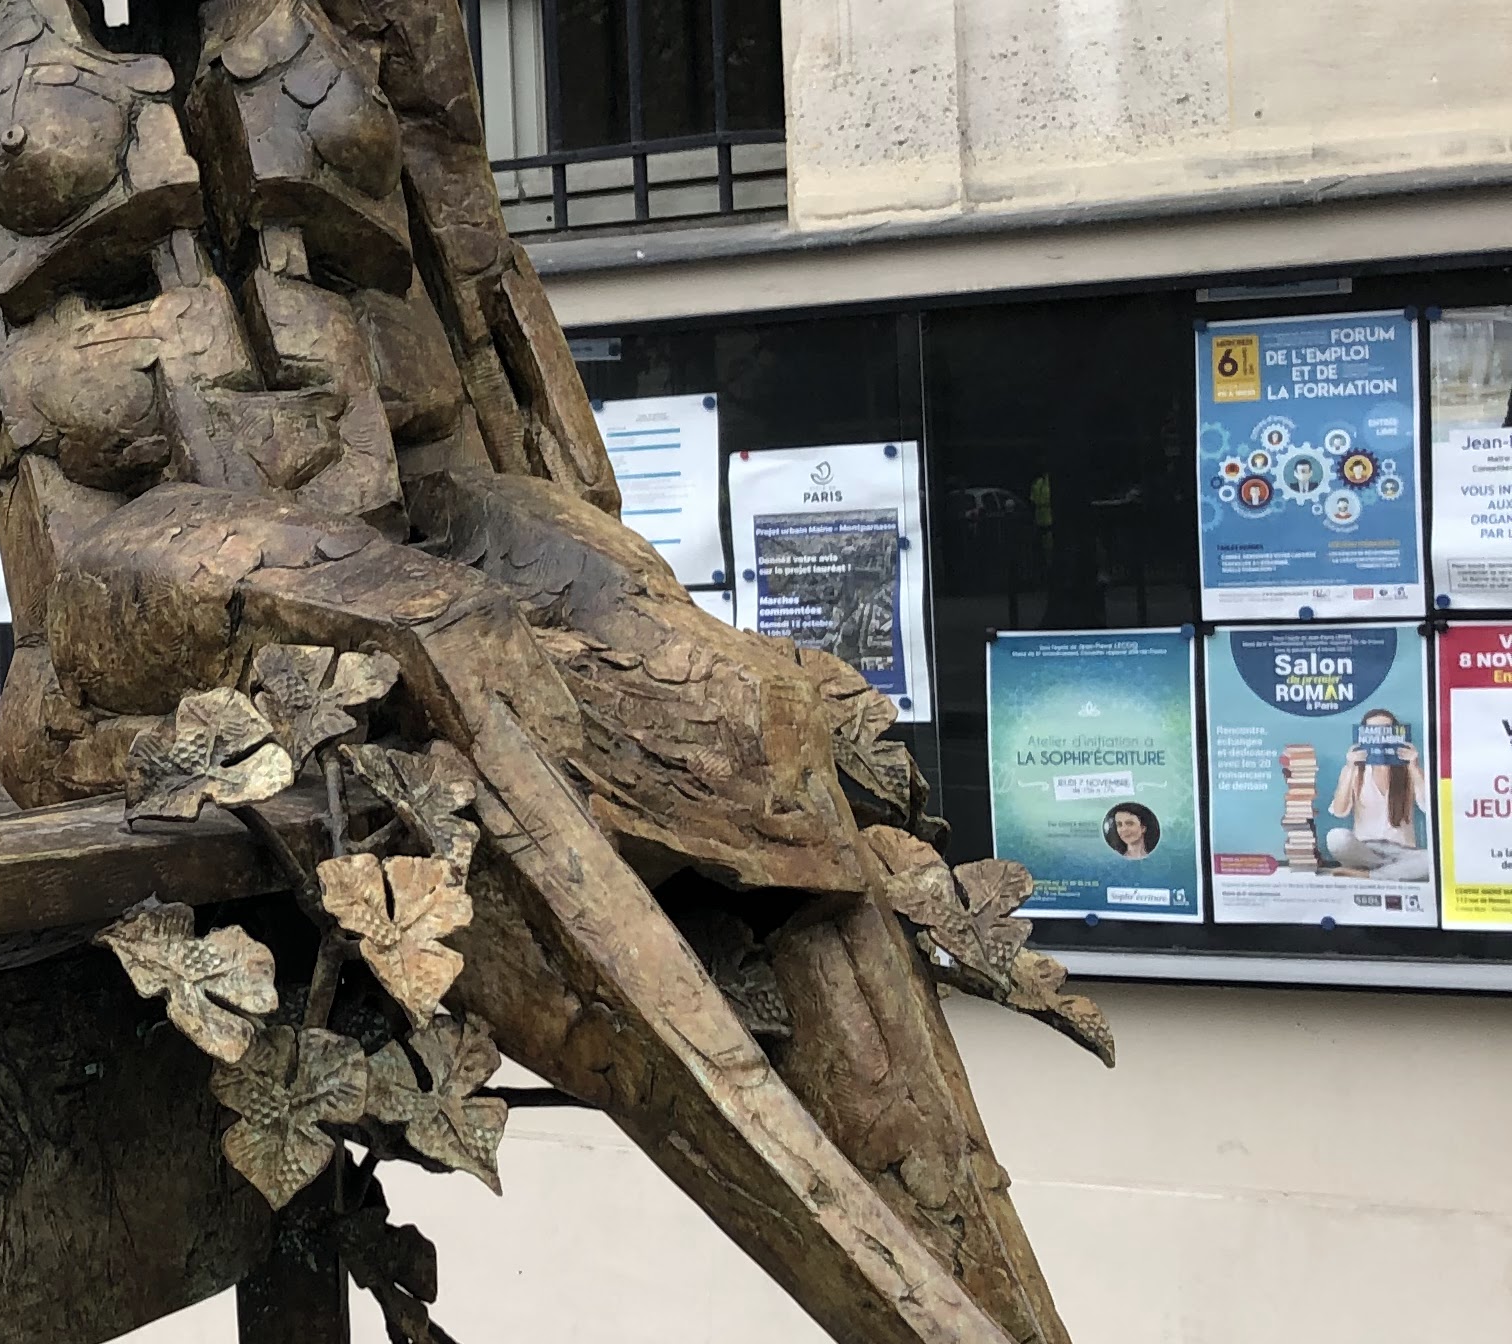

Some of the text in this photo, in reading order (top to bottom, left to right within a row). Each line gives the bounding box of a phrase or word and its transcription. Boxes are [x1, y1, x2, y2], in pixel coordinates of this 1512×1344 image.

[1330, 325, 1395, 344] FORUM
[1218, 348, 1238, 377] 6
[1265, 349, 1287, 366] DE
[1292, 344, 1369, 365] L'EMPLOI
[1292, 364, 1338, 381] ET DE
[1268, 377, 1397, 400] LA FORMATION
[1461, 435, 1512, 451] Jean-
[803, 490, 843, 504] PARIS
[1461, 485, 1495, 497] VOUS
[756, 528, 779, 537] Projet
[839, 524, 896, 533] Montparnasse
[1480, 528, 1505, 539] PAR
[793, 555, 817, 564] votre
[785, 565, 811, 576] projet
[760, 596, 799, 606] Marches
[760, 605, 822, 616] commentées
[1275, 653, 1352, 675] Salon
[1459, 652, 1472, 668] 8
[1275, 683, 1353, 702] ROMAN
[1314, 701, 1339, 710] Paris
[1028, 735, 1067, 748] Atelier
[1145, 735, 1154, 747] à
[1017, 747, 1166, 767] LA SOPHR'ÉCRITURE
